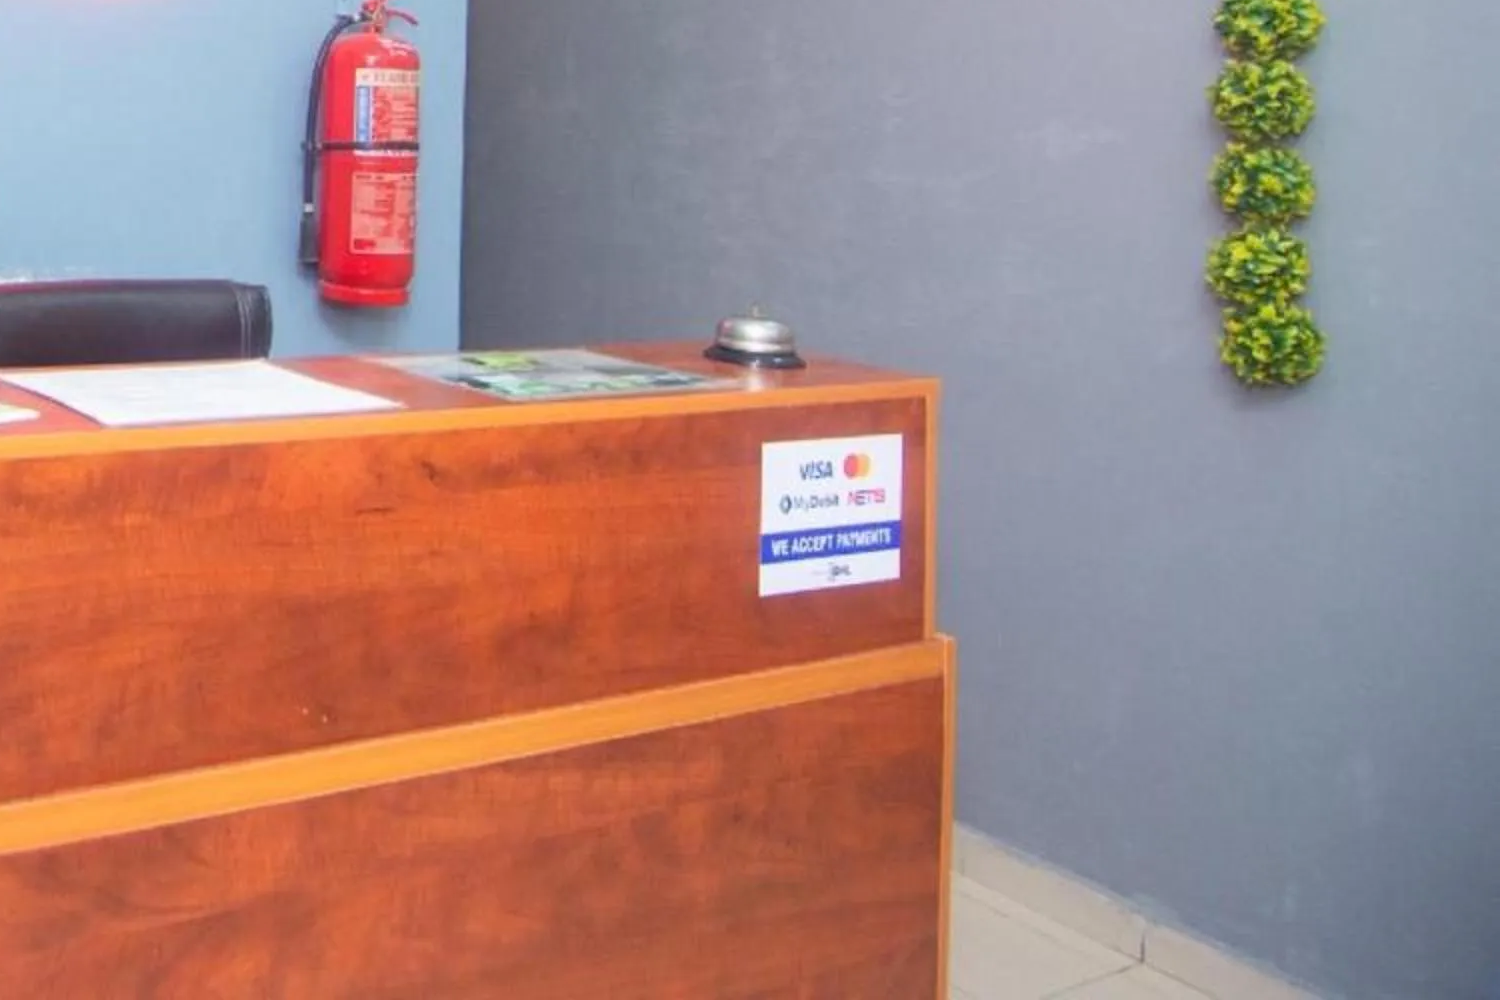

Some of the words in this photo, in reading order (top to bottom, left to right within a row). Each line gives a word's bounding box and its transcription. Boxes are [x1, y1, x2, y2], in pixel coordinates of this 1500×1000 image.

[799, 460, 834, 480] VISA
[771, 539, 790, 557] WE
[791, 534, 833, 553] ACCEPT
[835, 527, 892, 550] PAYMENTS
